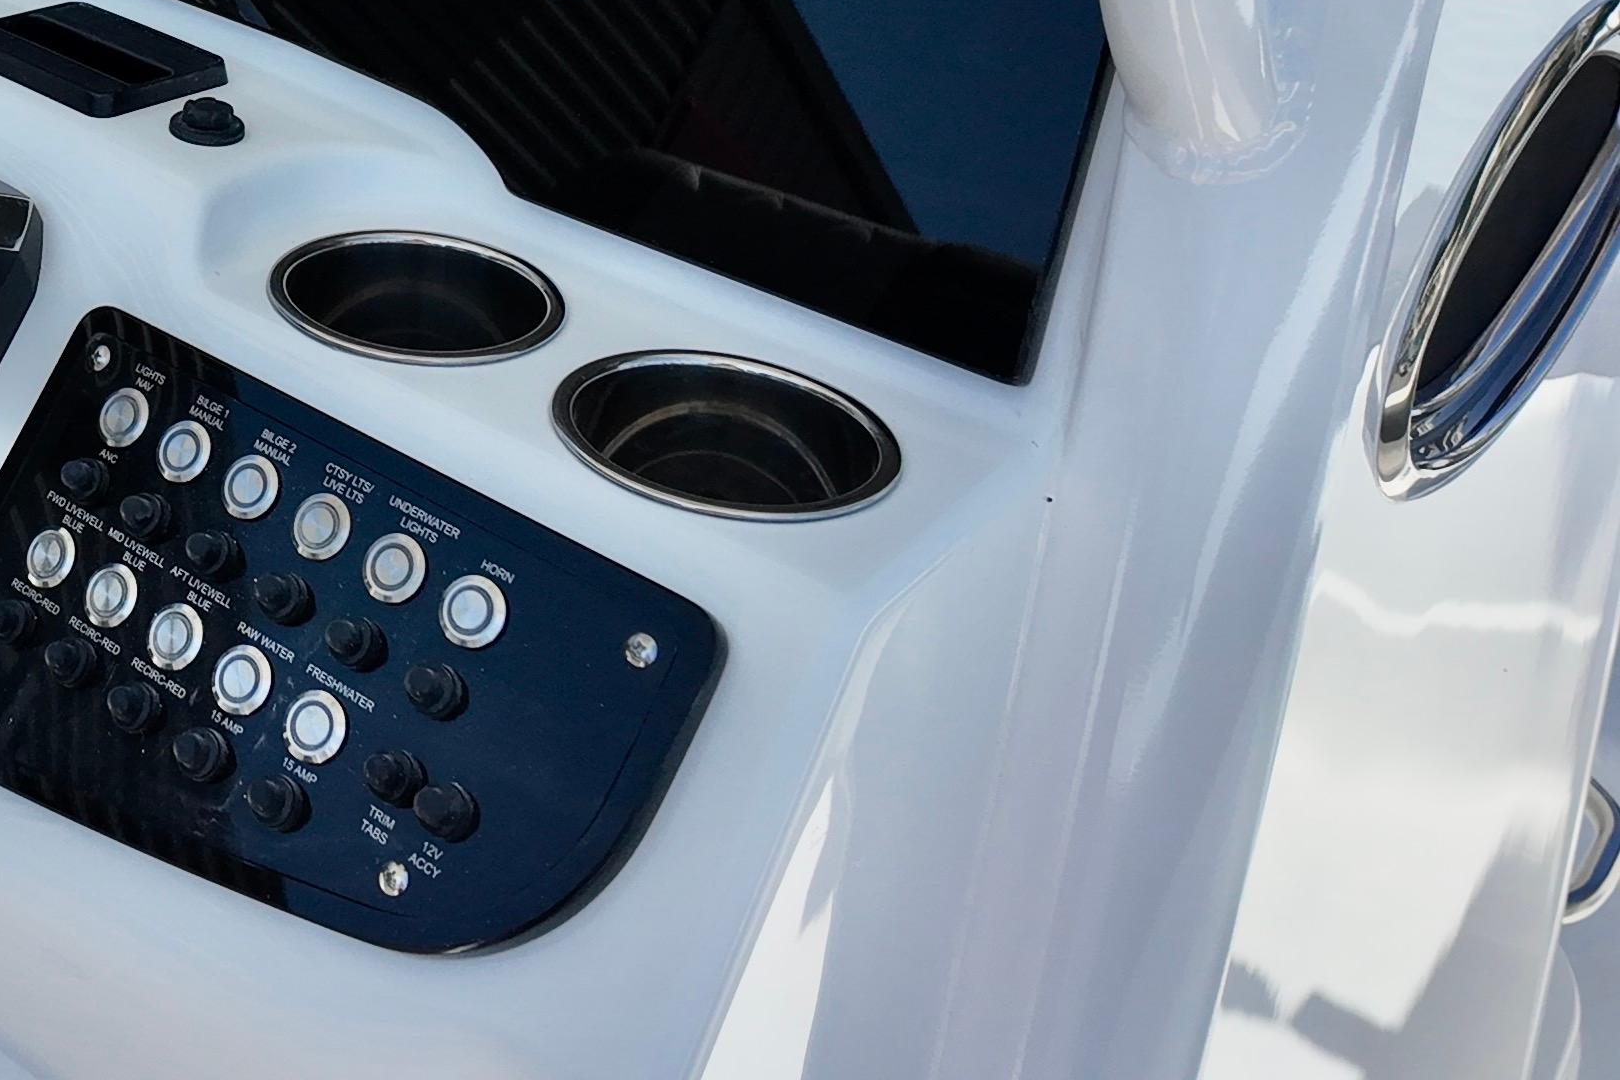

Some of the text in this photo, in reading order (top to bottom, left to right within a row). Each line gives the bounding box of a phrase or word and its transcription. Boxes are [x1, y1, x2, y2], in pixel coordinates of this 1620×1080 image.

[135, 363, 166, 385] LIGHTS
[135, 377, 154, 392] NAV
[188, 405, 225, 431] MANUAL
[196, 394, 225, 416] BILGE
[253, 439, 291, 467] MANUAL
[260, 428, 297, 454] BILGE 2
[98, 448, 118, 464] ANC
[322, 476, 364, 505] LIVE LTS
[325, 462, 375, 493] CTSY LTS/
[46, 490, 103, 532] FWD LIVEWELL
[61, 514, 85, 535] BLUE
[388, 495, 461, 540] UNDERWATER
[400, 516, 439, 544] LIGHTS
[107, 526, 164, 569] MID LIVEWELL
[122, 551, 146, 572] BLUE
[480, 559, 515, 584] HORN
[10, 578, 60, 615] RECIRC-RED
[170, 565, 231, 609] AFT LIVEWELL
[187, 590, 213, 612] BLUE
[68, 615, 121, 656] RECIRC-RED
[237, 621, 295, 664] RAW WATER
[131, 656, 186, 699] RECIRC-RED
[305, 664, 375, 713] FRESHWATER
[211, 709, 244, 736] 15 AMP
[282, 757, 318, 785] 15 AMP
[369, 805, 396, 830] TRIM
[360, 819, 389, 844] TABS
[421, 841, 443, 860] 12V
[407, 853, 442, 879] ACCY
